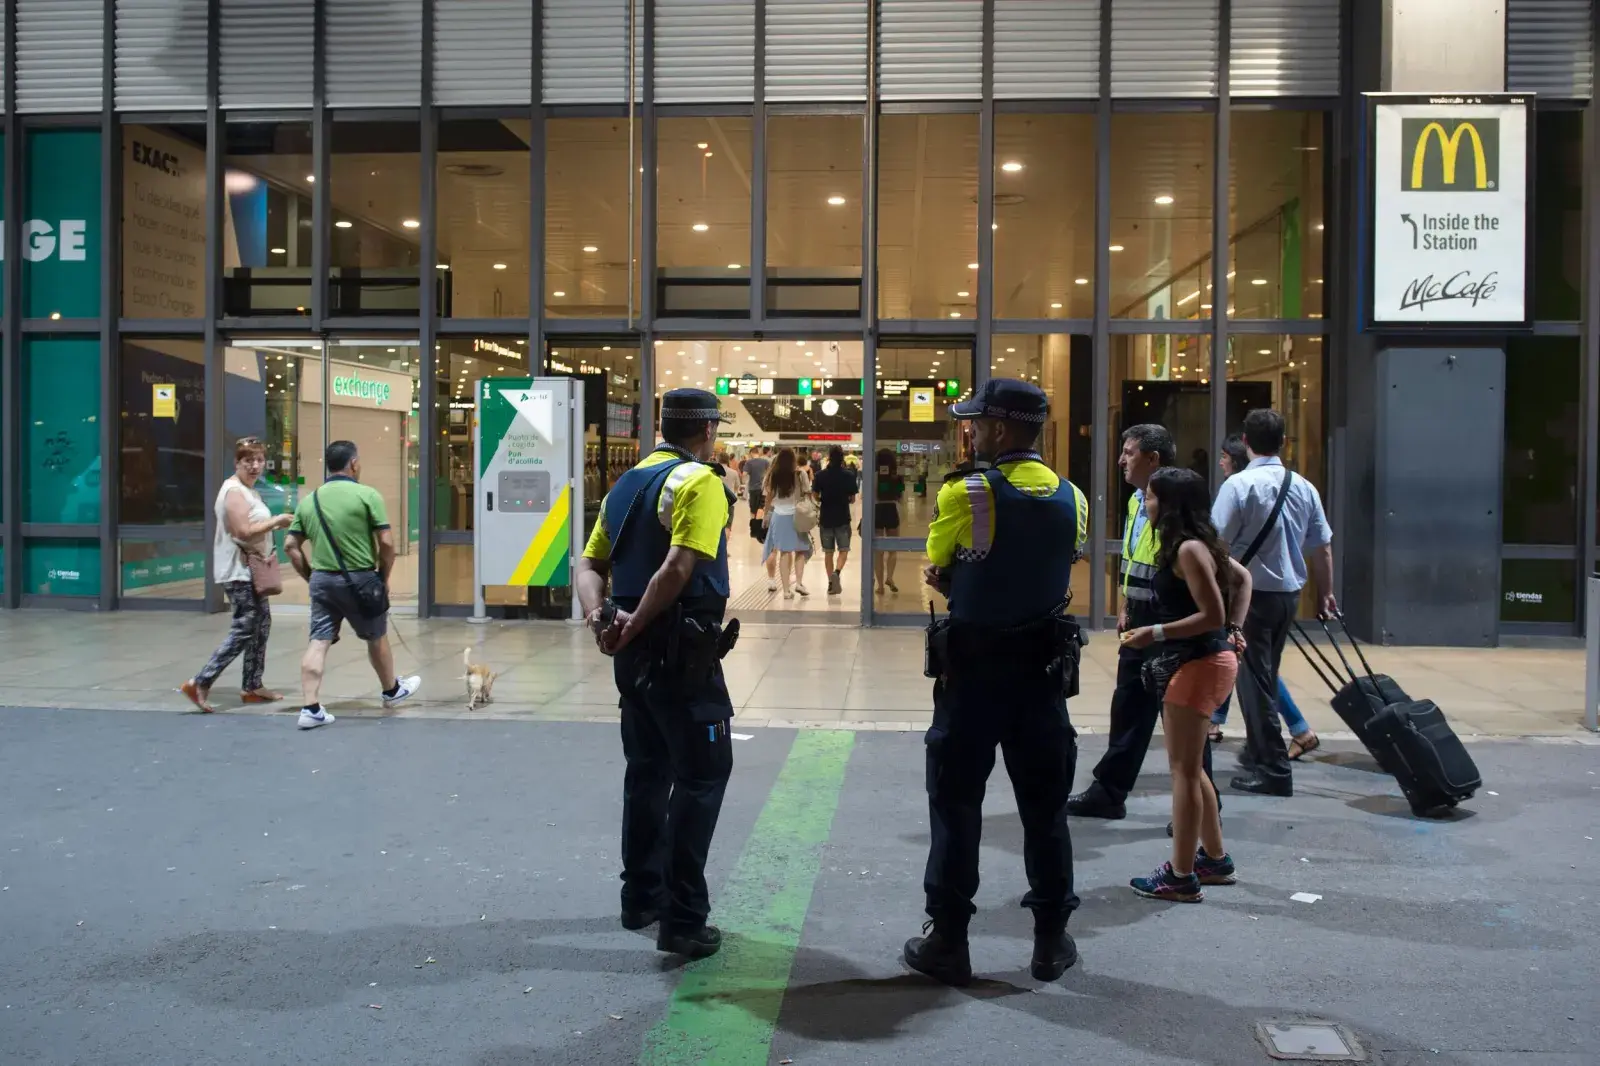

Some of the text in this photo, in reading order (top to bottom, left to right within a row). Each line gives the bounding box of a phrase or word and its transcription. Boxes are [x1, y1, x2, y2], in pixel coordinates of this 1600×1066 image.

[0, 219, 86, 262] GE
[1423, 213, 1499, 231] Inside the
[1423, 233, 1477, 251] Station
[1400, 270, 1498, 311] McCafé
[333, 369, 390, 406] exchange
